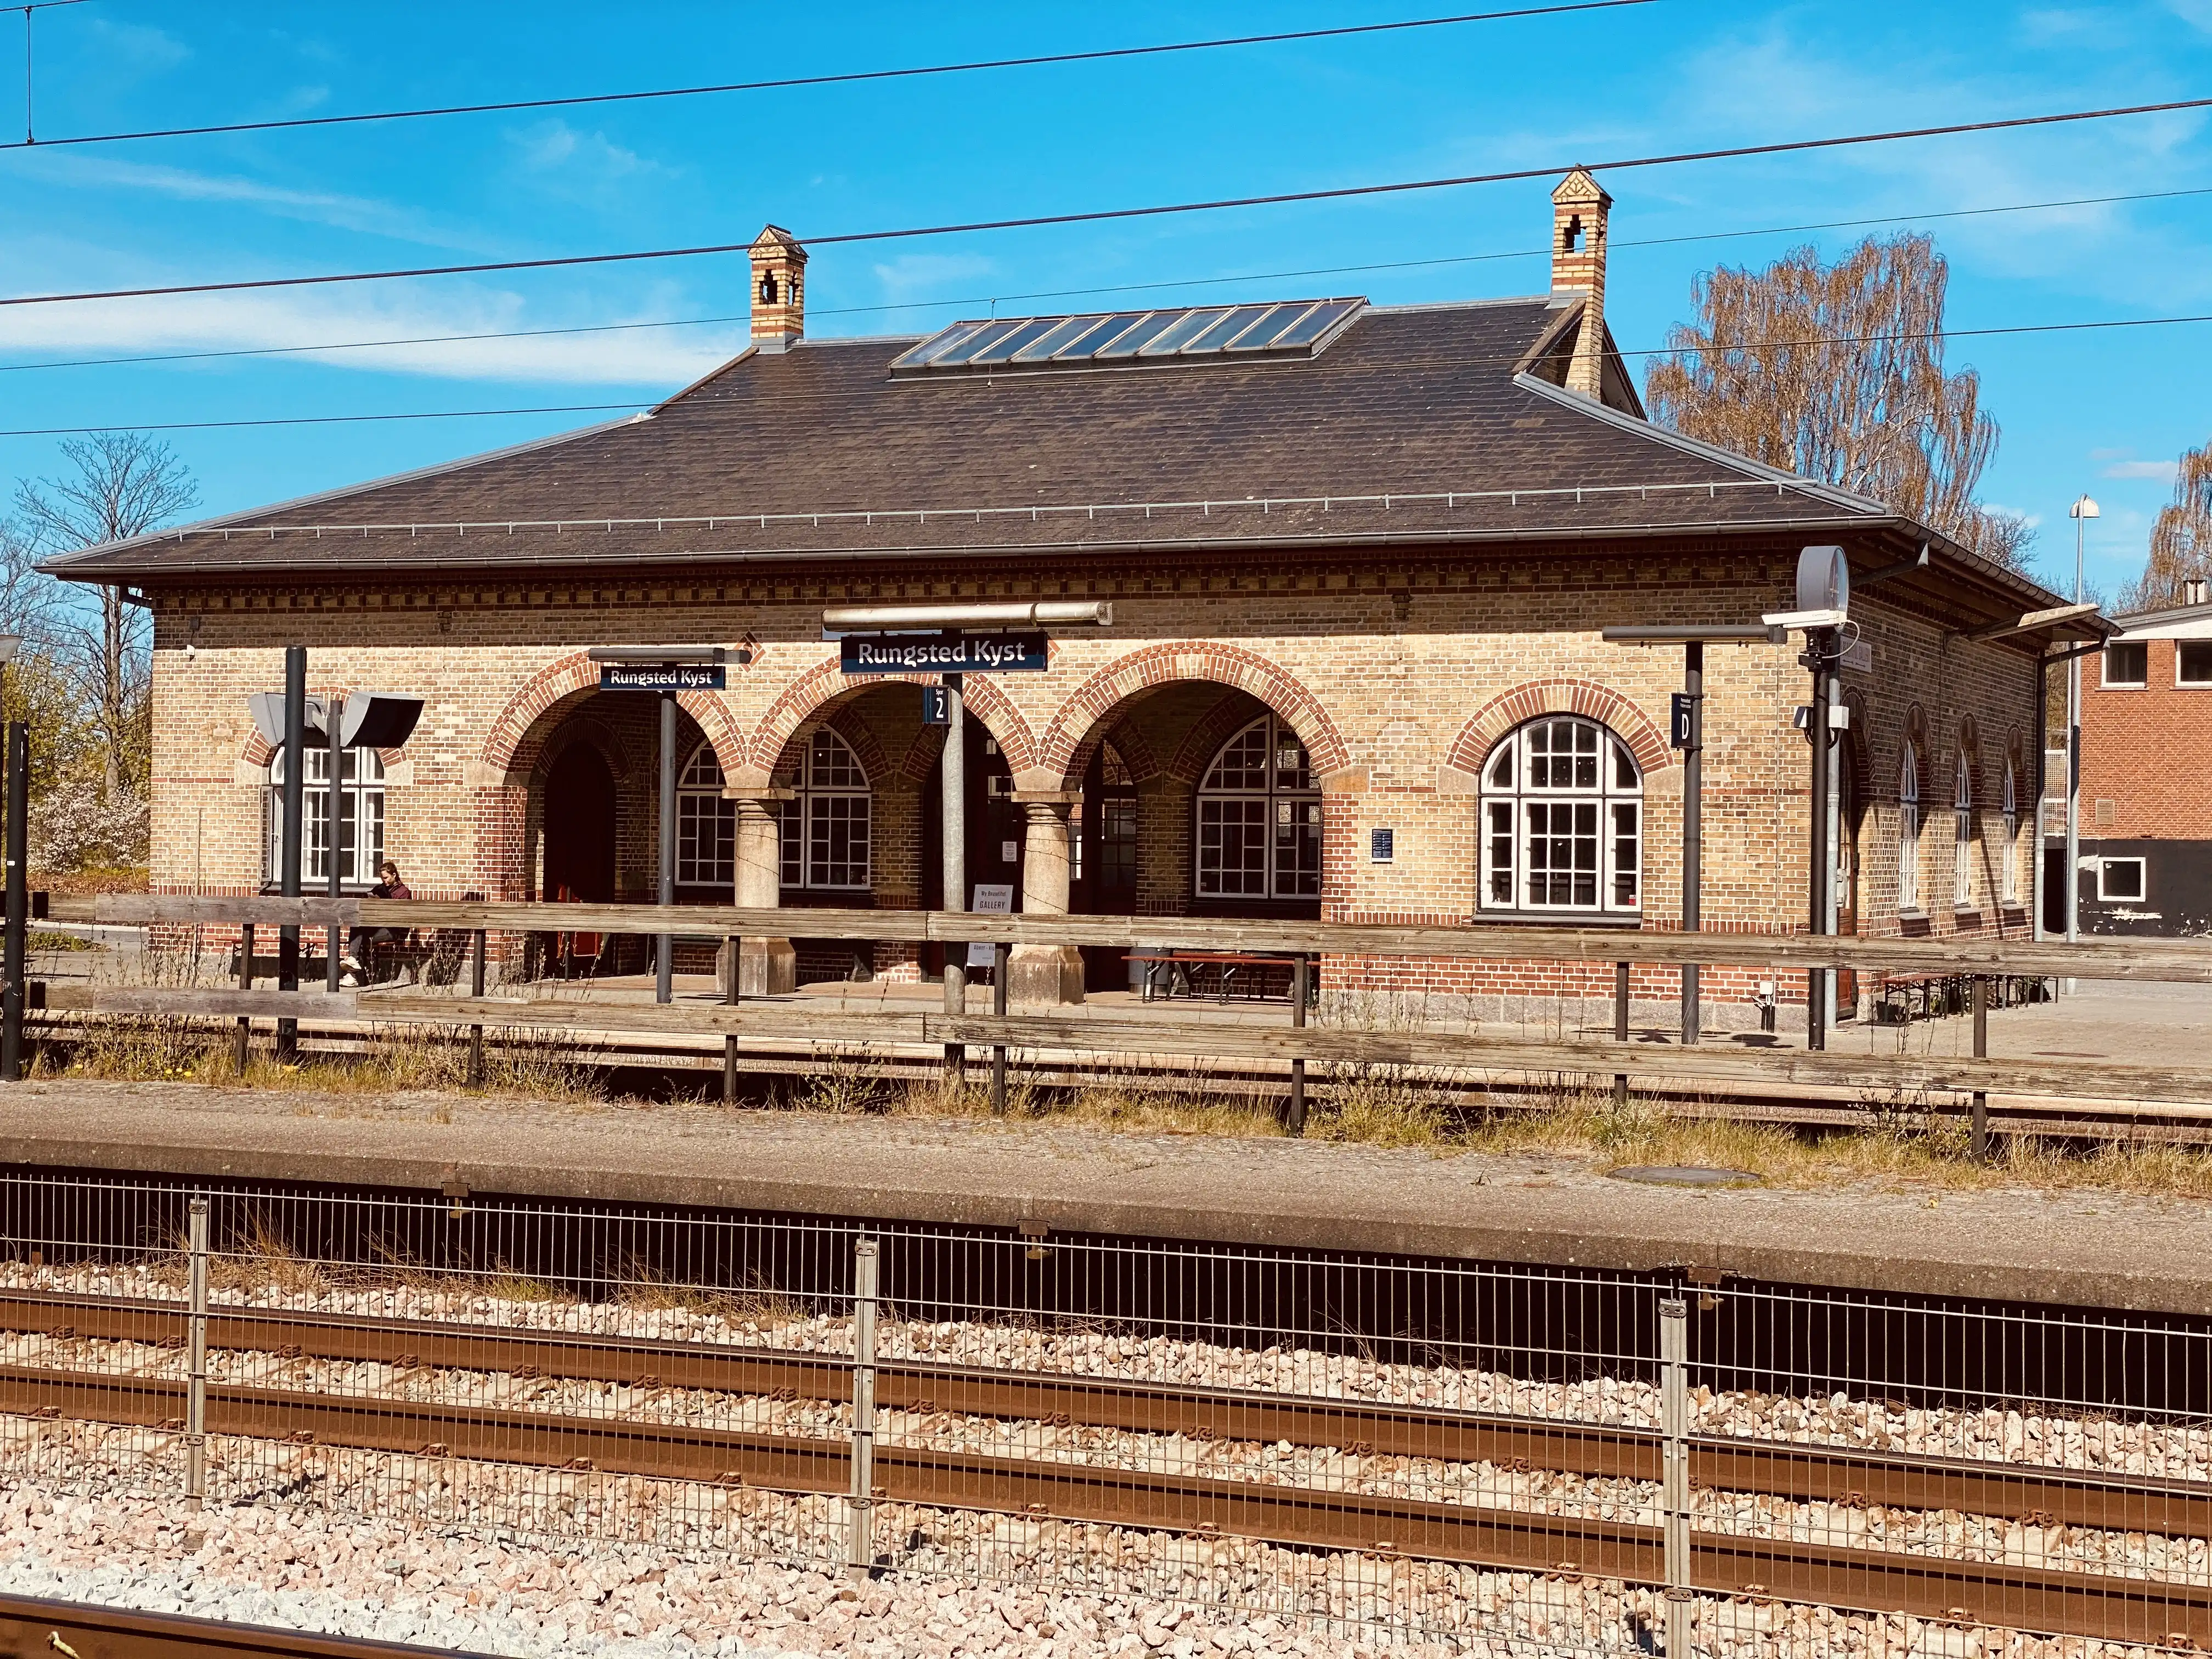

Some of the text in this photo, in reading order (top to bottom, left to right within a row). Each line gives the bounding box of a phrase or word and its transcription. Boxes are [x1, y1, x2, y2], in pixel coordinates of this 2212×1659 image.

[859, 640, 1025, 668] Rungsted Kyst
[611, 670, 712, 687] Rungsted Kyst
[936, 697, 944, 718] 2
[1681, 713, 1689, 740] D
[979, 901, 1005, 909] GALLERY
